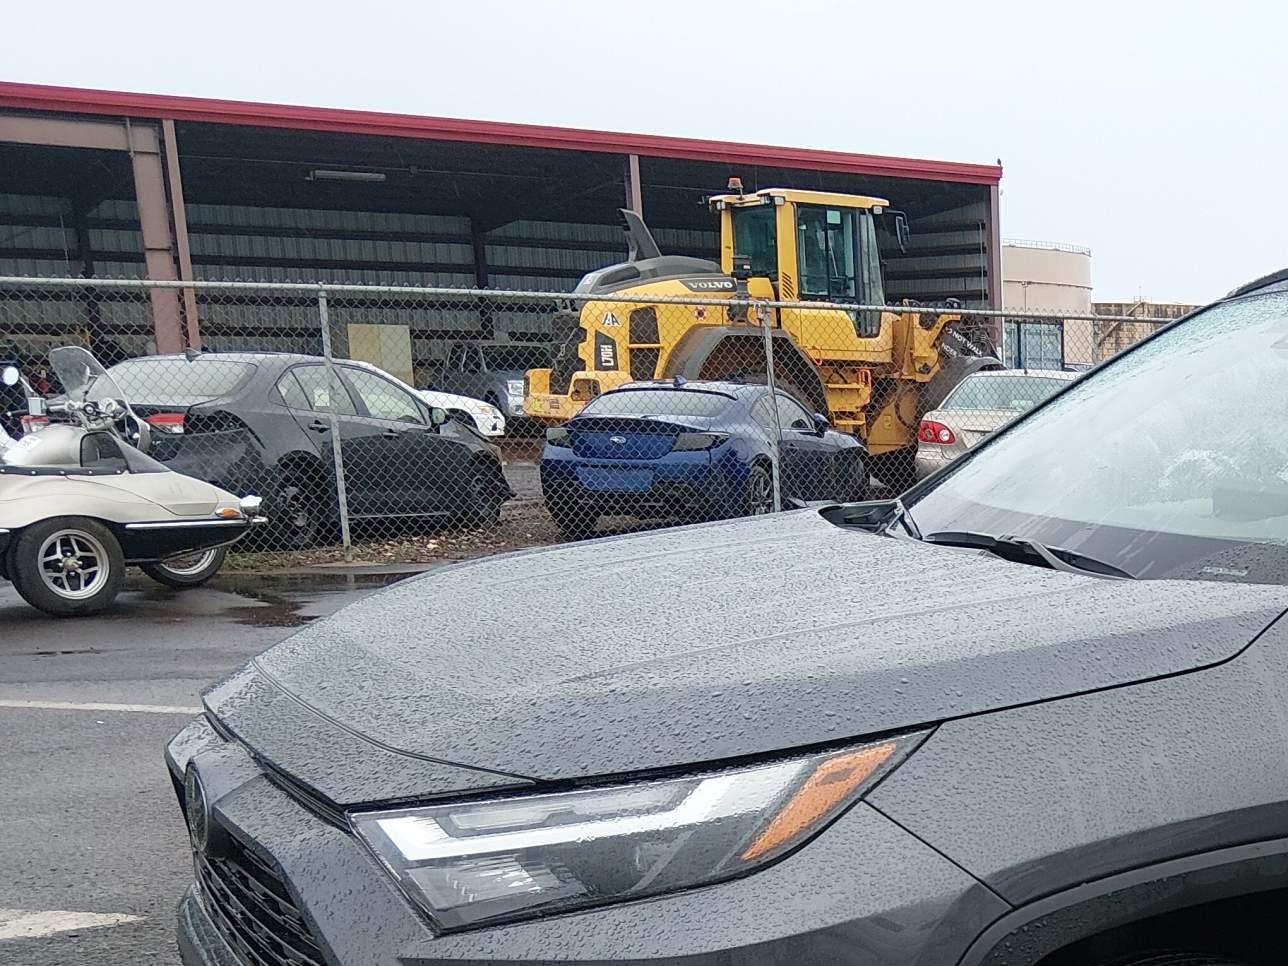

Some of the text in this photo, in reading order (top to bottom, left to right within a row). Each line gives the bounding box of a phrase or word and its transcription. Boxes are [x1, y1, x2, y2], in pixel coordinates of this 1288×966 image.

[688, 281, 733, 289] VOLVO
[952, 331, 967, 344] NOT
[600, 344, 614, 366] L70H
